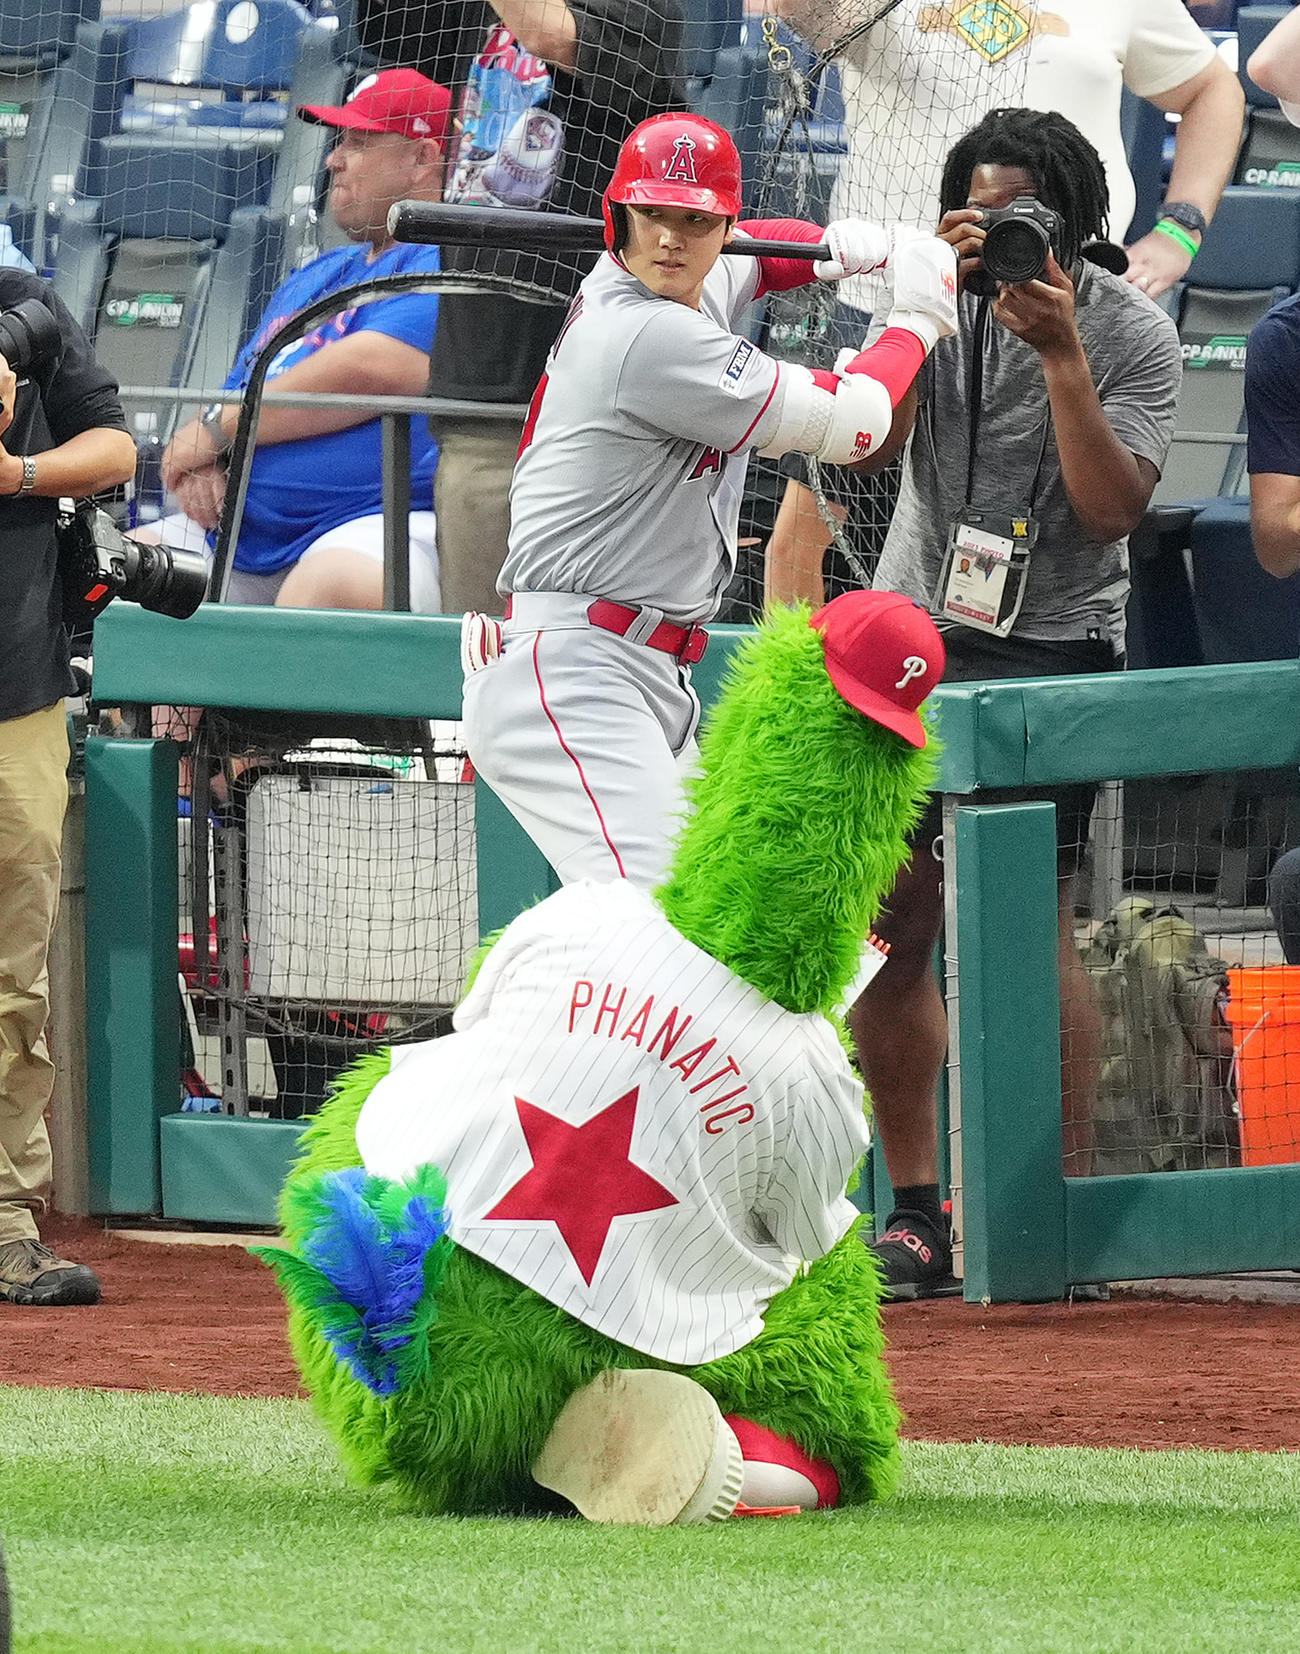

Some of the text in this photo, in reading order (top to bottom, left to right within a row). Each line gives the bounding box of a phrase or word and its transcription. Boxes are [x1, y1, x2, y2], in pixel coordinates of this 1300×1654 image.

[664, 133, 697, 183] A
[895, 655, 927, 689] P
[568, 980, 755, 1135] PHANATIC
